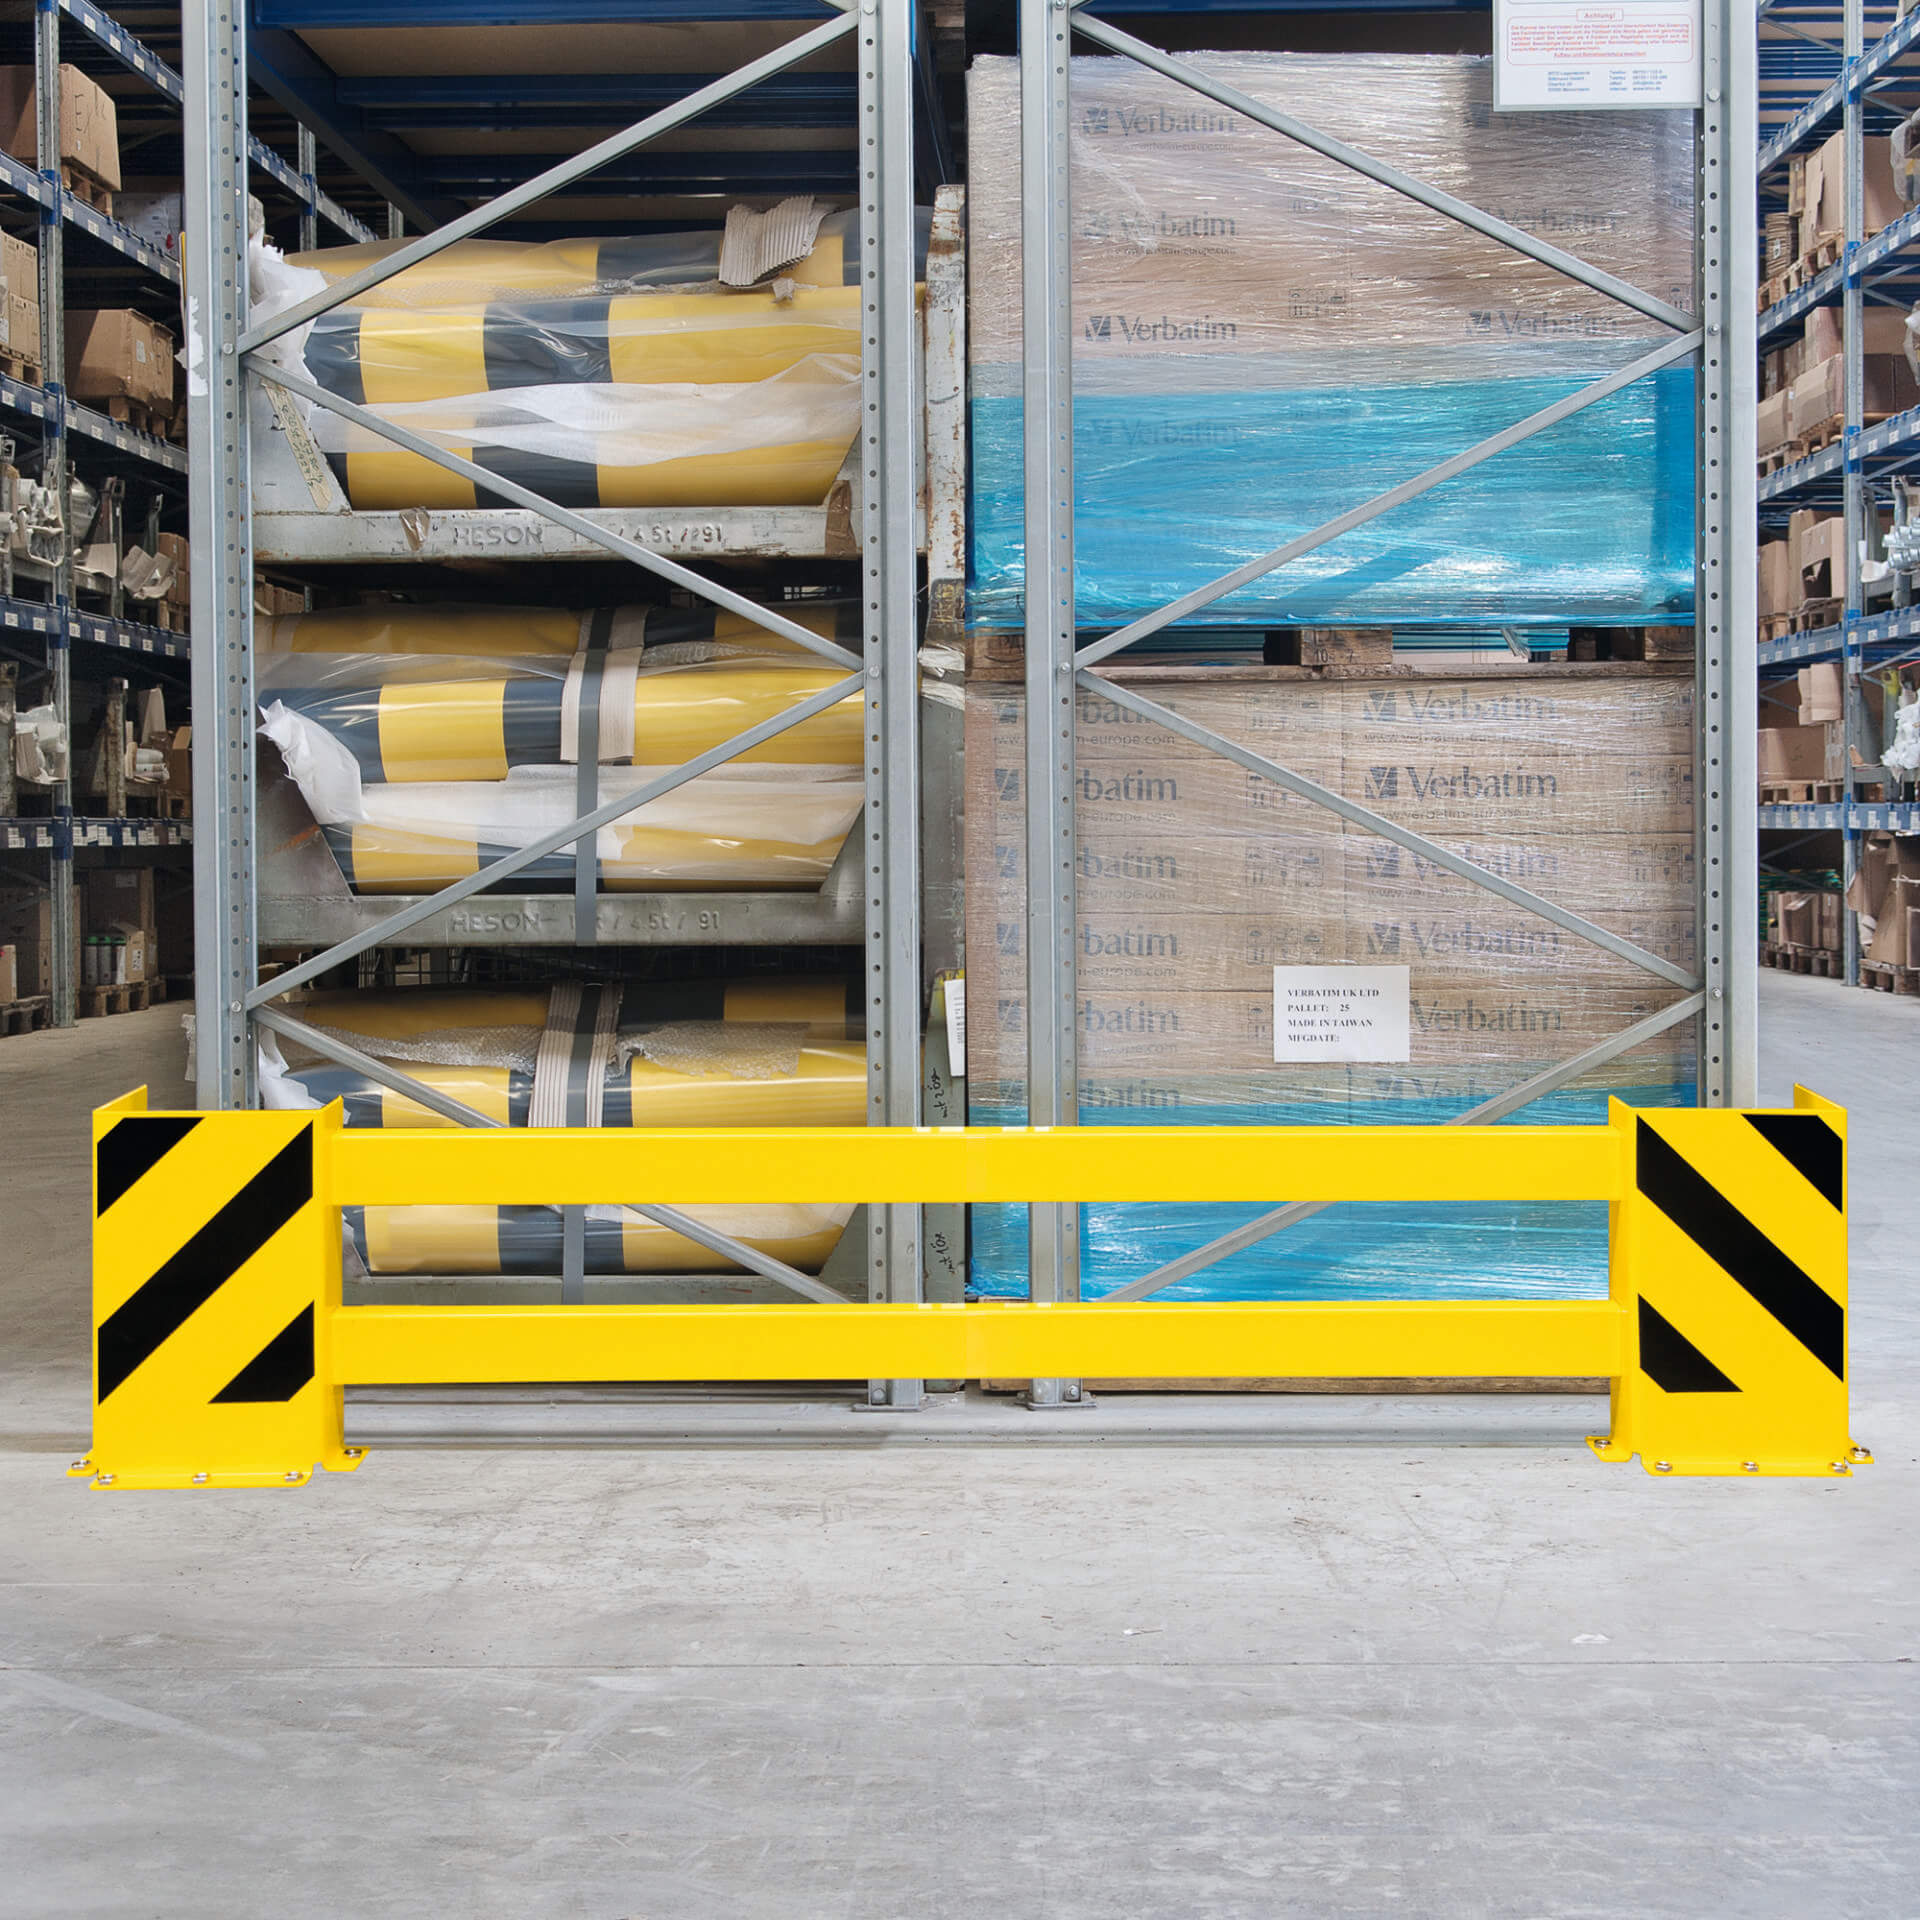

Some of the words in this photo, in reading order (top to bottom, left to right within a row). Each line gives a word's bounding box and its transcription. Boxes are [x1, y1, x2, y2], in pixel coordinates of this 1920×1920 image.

[1116, 106, 1235, 136] Verbatim
[1117, 314, 1238, 344] Verbatim
[1405, 688, 1561, 724] Verbatim
[1405, 766, 1558, 801] Verbatim
[699, 911, 720, 931] 91
[1410, 922, 1561, 957] Verbatim
[1287, 989, 1340, 998] VERBATIM
[1342, 989, 1357, 998] UK
[1359, 989, 1380, 998] LTD
[1287, 1004, 1329, 1013] PALLET:
[1340, 1004, 1351, 1013] 25
[1288, 1019, 1317, 1027] MADE
[1319, 1019, 1331, 1027] IN
[1333, 1019, 1374, 1027] TAIWAN
[1411, 1000, 1562, 1032] Verbatim
